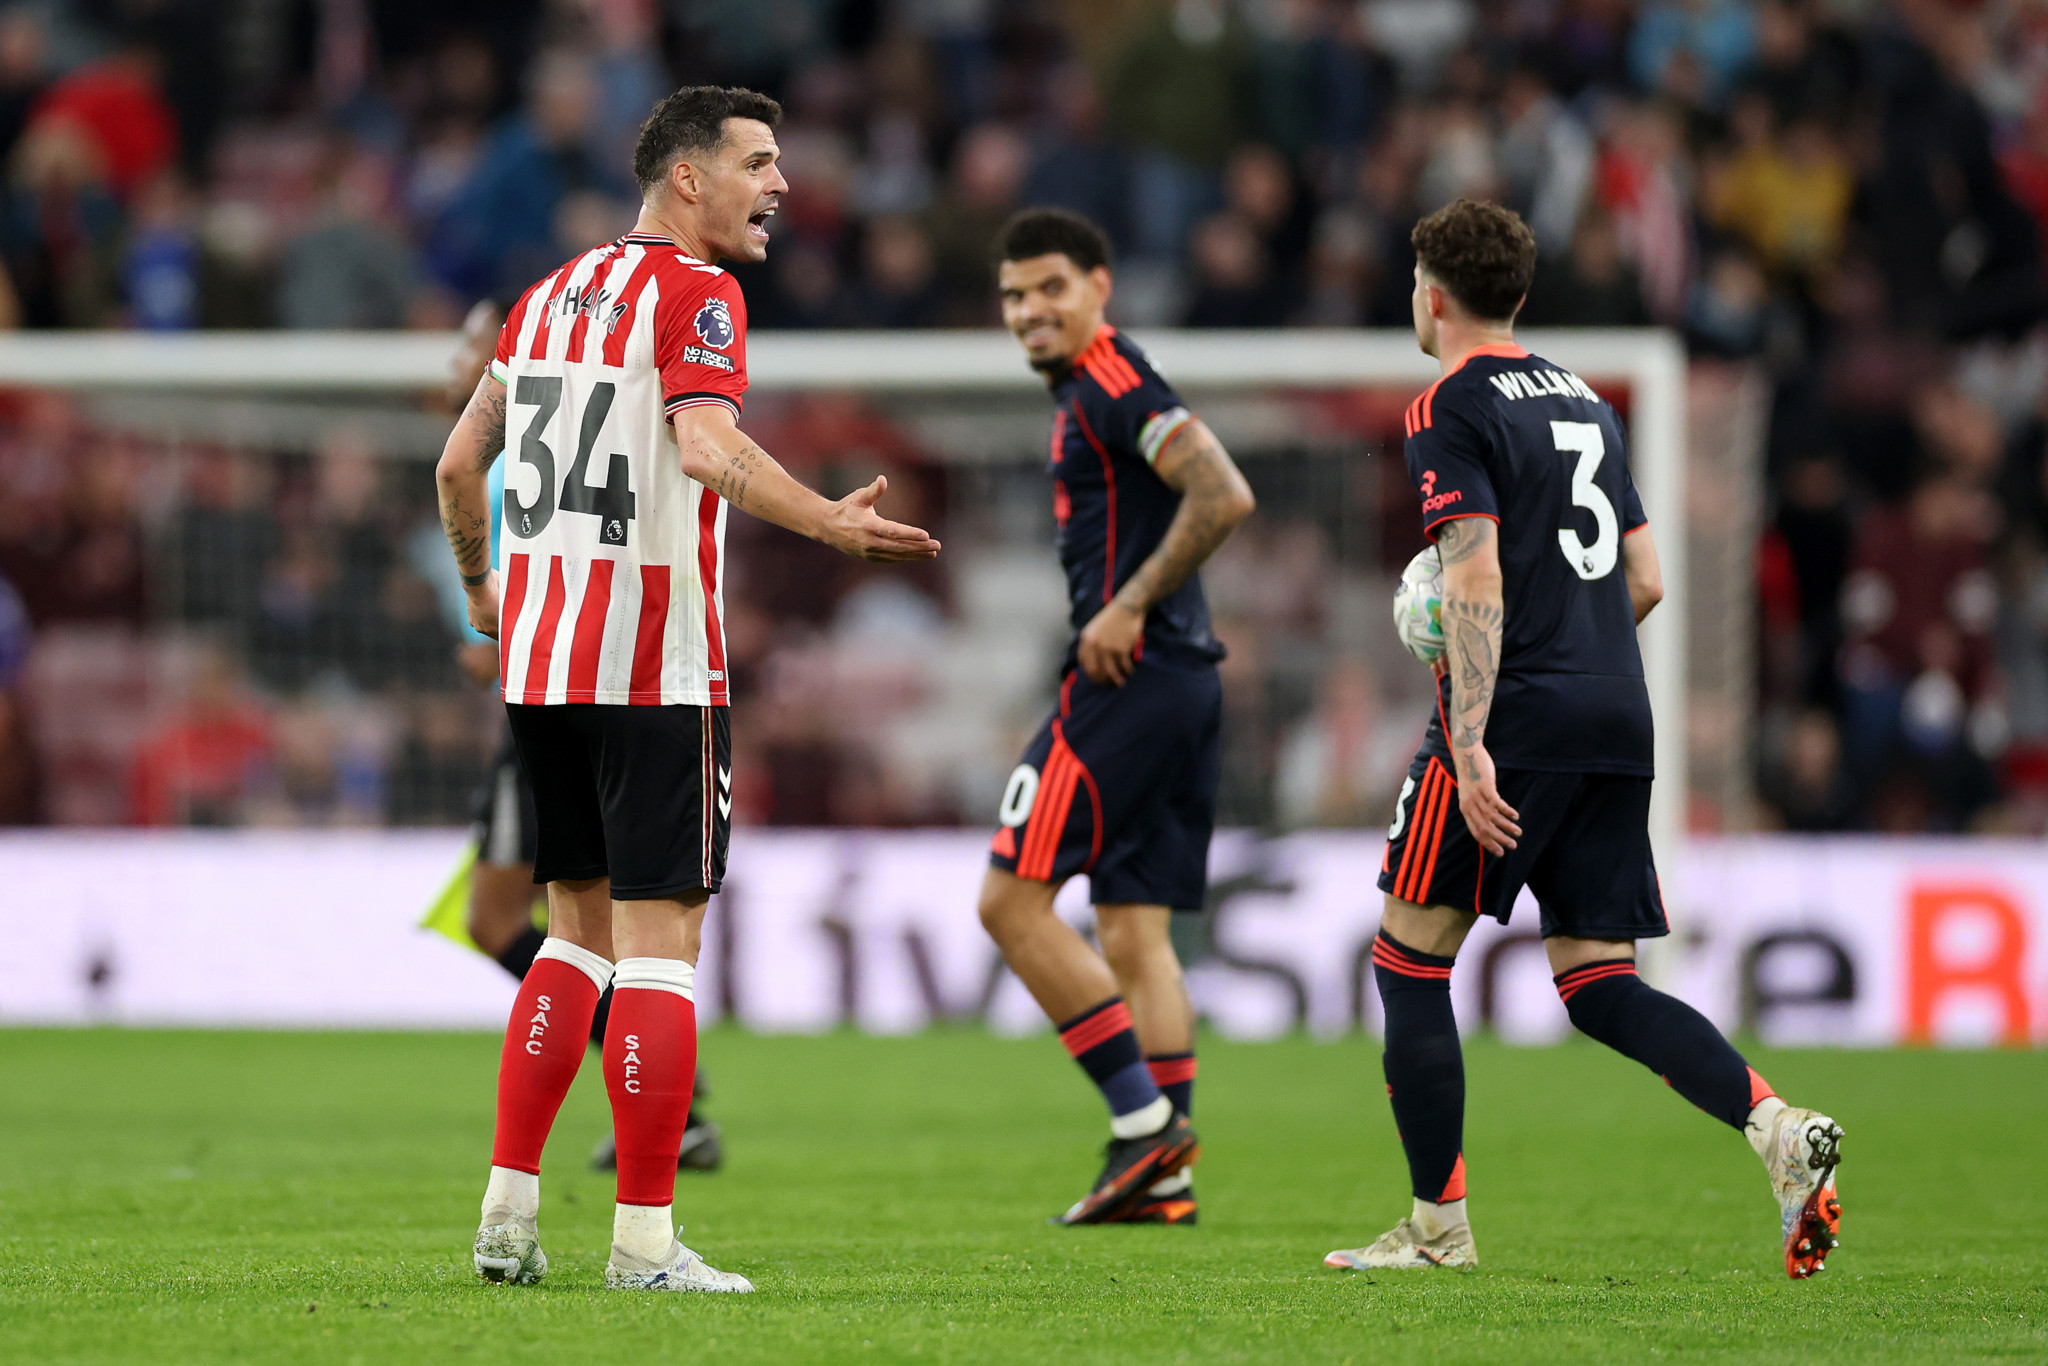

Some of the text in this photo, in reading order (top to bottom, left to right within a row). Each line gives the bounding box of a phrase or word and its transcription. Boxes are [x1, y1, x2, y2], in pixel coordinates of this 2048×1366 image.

[544, 285, 629, 335] XHAKA
[684, 345, 730, 365] No room
[700, 356, 734, 373] racism
[503, 375, 636, 547] 34
[1549, 420, 1620, 581] 3
[525, 994, 553, 1056] SAFC
[622, 1033, 643, 1094] SAFC
